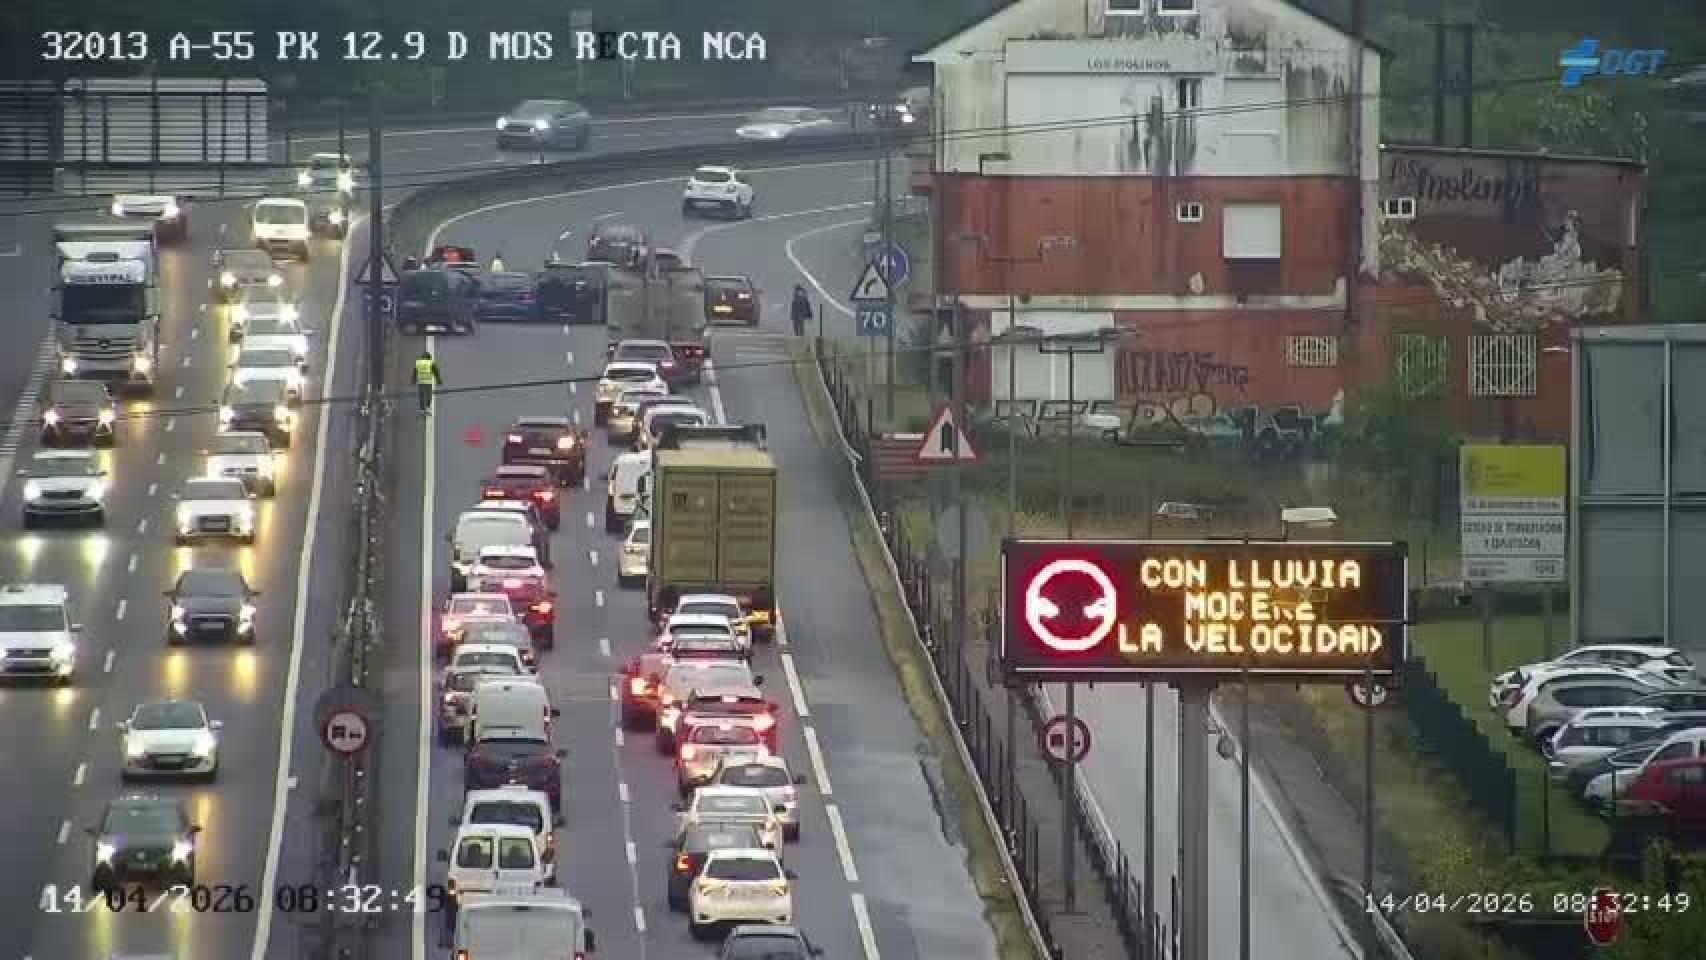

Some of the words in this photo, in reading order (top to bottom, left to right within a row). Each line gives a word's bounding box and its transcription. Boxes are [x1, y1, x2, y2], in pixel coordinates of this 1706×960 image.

[859, 311, 886, 329] 70
[1140, 559, 1207, 589] CON
[1228, 559, 1361, 589] LLUVIA
[1118, 623, 1163, 653] LA
[1184, 623, 1383, 653] VELOCIDAD
